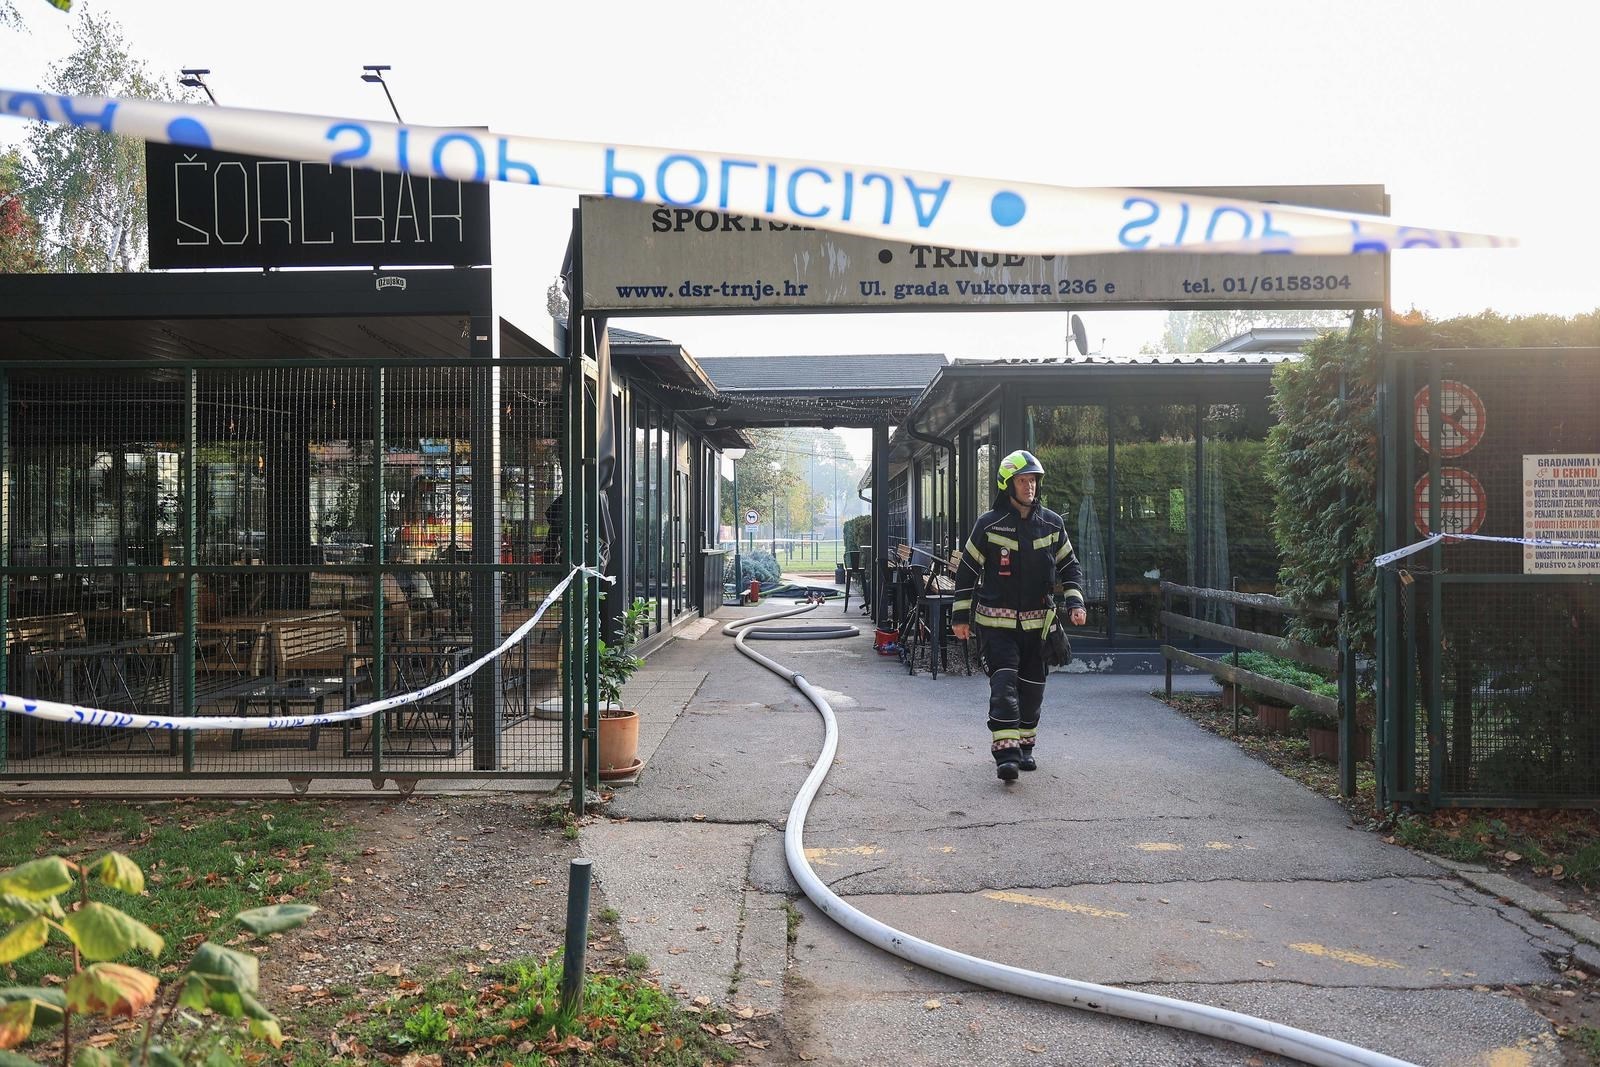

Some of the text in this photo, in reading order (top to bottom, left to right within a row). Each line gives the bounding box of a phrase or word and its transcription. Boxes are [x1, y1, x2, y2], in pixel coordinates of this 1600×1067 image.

[174, 153, 335, 246] ŠORC
[651, 204, 816, 233] ŠPORTS
[909, 245, 1026, 268] TRNJE
[616, 274, 1351, 300] www.dsr-trnje.hr Ul. grada Vukovara 236 e tel. 01/6158304
[1553, 468, 1598, 478] U CENTRU
